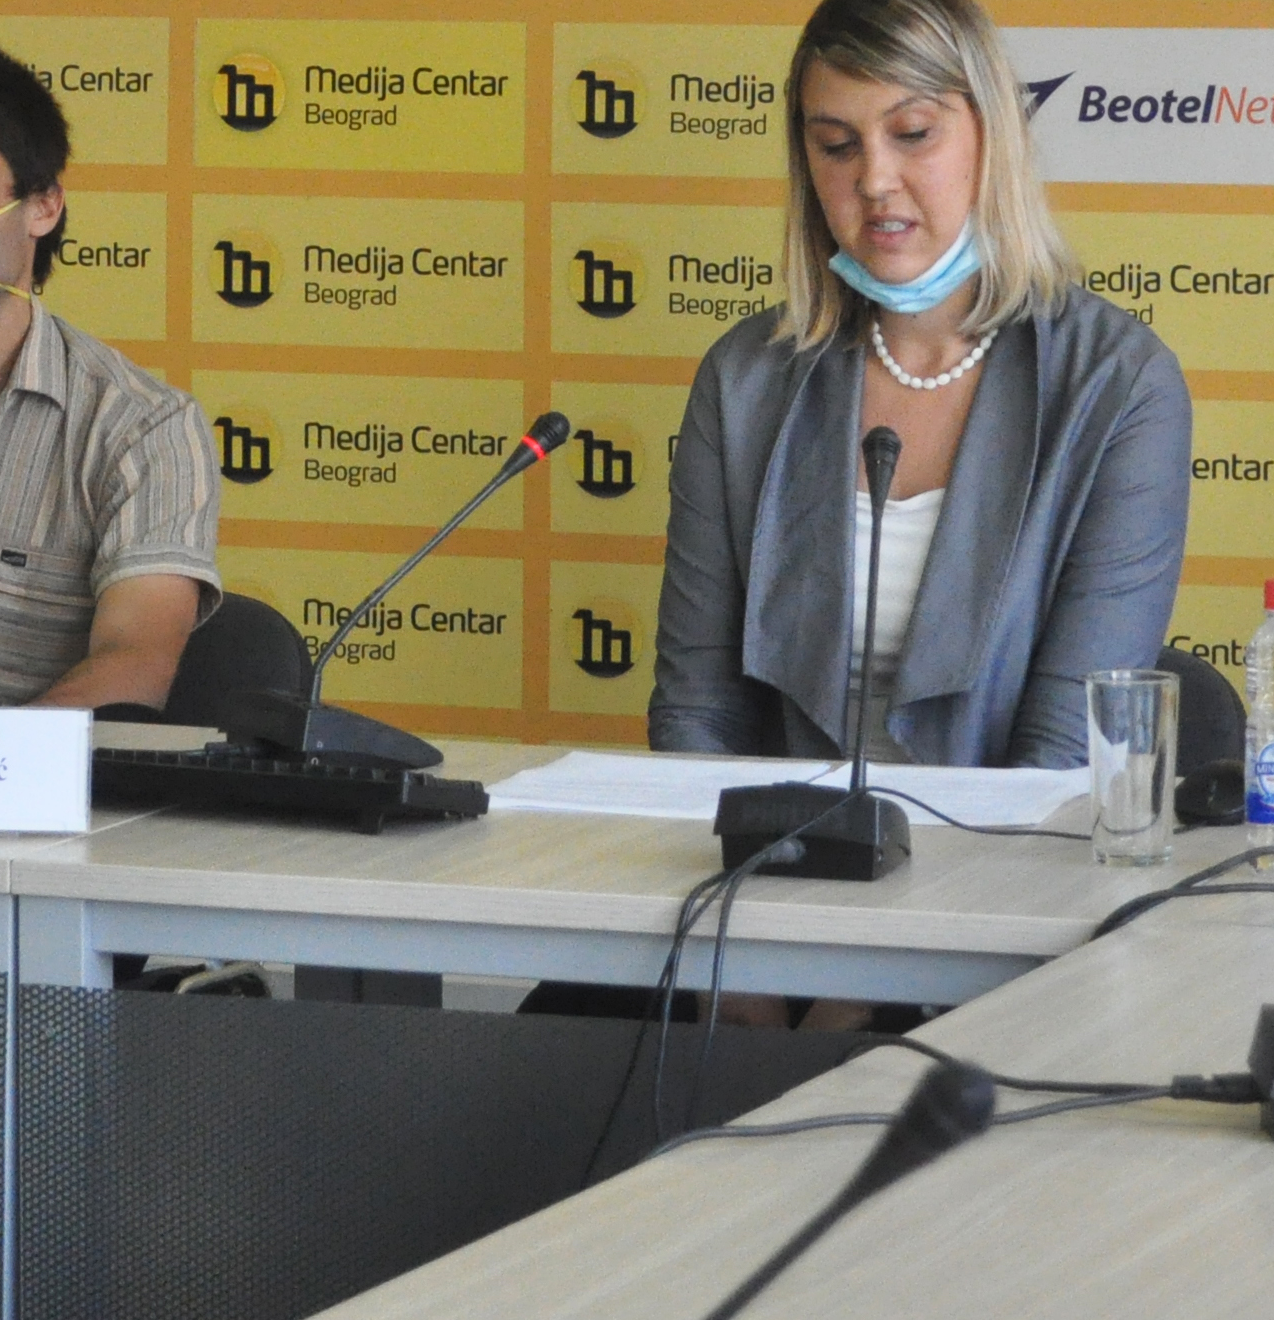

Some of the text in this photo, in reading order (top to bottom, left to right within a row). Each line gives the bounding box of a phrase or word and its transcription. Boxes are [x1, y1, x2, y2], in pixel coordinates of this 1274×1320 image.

[304, 65, 509, 105] Medija Centar
[669, 72, 776, 107] Medija
[304, 102, 398, 131] Beograd
[670, 111, 767, 140] Beograd
[303, 244, 509, 285] Medija Centar
[304, 281, 397, 311] Beograd
[303, 421, 509, 459] Medija Centar
[304, 458, 397, 488] Beograd
